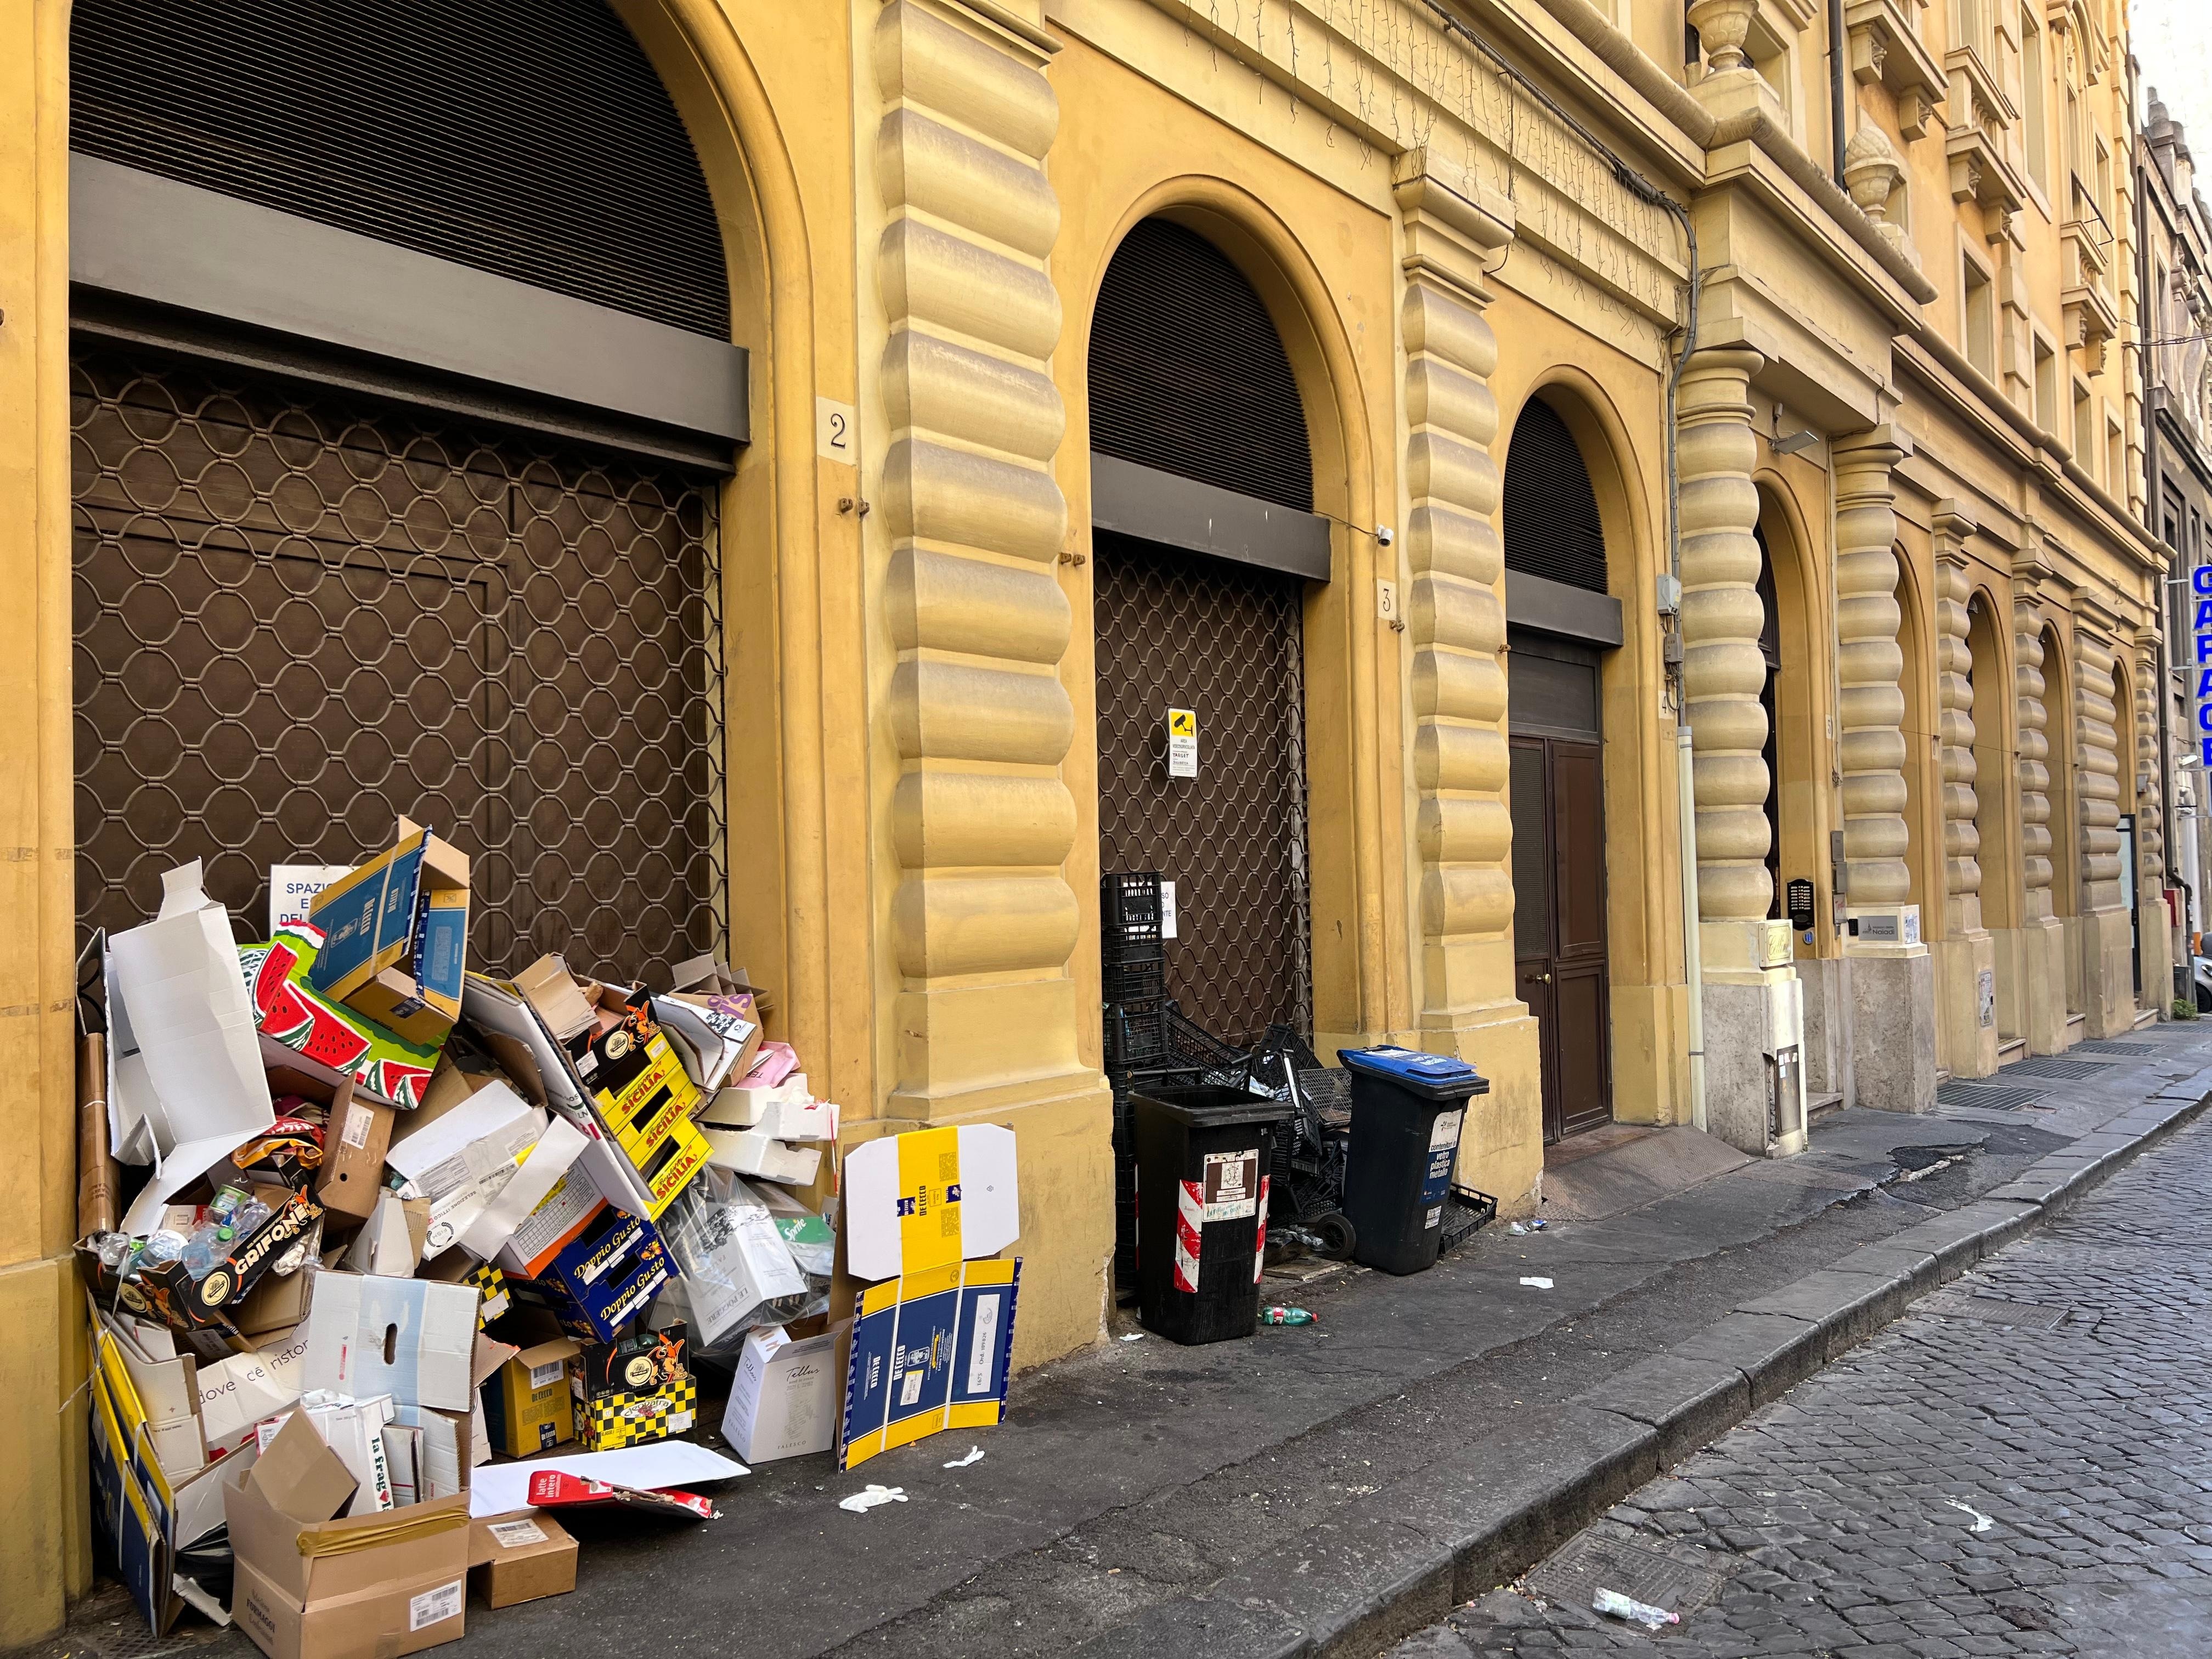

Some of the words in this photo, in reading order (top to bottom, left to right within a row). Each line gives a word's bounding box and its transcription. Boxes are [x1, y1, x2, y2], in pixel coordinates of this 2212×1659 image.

[831, 414, 846, 449] 2
[1383, 588, 1390, 612] 3
[622, 1070, 665, 1115] SICILIA
[646, 1102, 685, 1147] SICILIA
[1430, 1159, 1451, 1172] plastica
[1436, 1151, 1449, 1160] vetro
[657, 1154, 697, 1200] SICILIA
[1429, 1168, 1448, 1180] metallo
[451, 1190, 476, 1210] SELEZIONE
[434, 1208, 450, 1220] ITTICO
[235, 1204, 308, 1274] GRIFONE
[612, 1216, 640, 1248] Gusto
[784, 1218, 807, 1241] Sprite
[601, 1284, 636, 1321] Doppio
[636, 1257, 664, 1289] Gusto
[744, 1356, 757, 1381] Tellus
[786, 1365, 820, 1381] Tellus
[538, 1389, 552, 1400] CECCO
[371, 1437, 380, 1454] la
[777, 1440, 807, 1449] FALESCO
[374, 1455, 387, 1492] frag
[536, 1478, 548, 1496] latte
